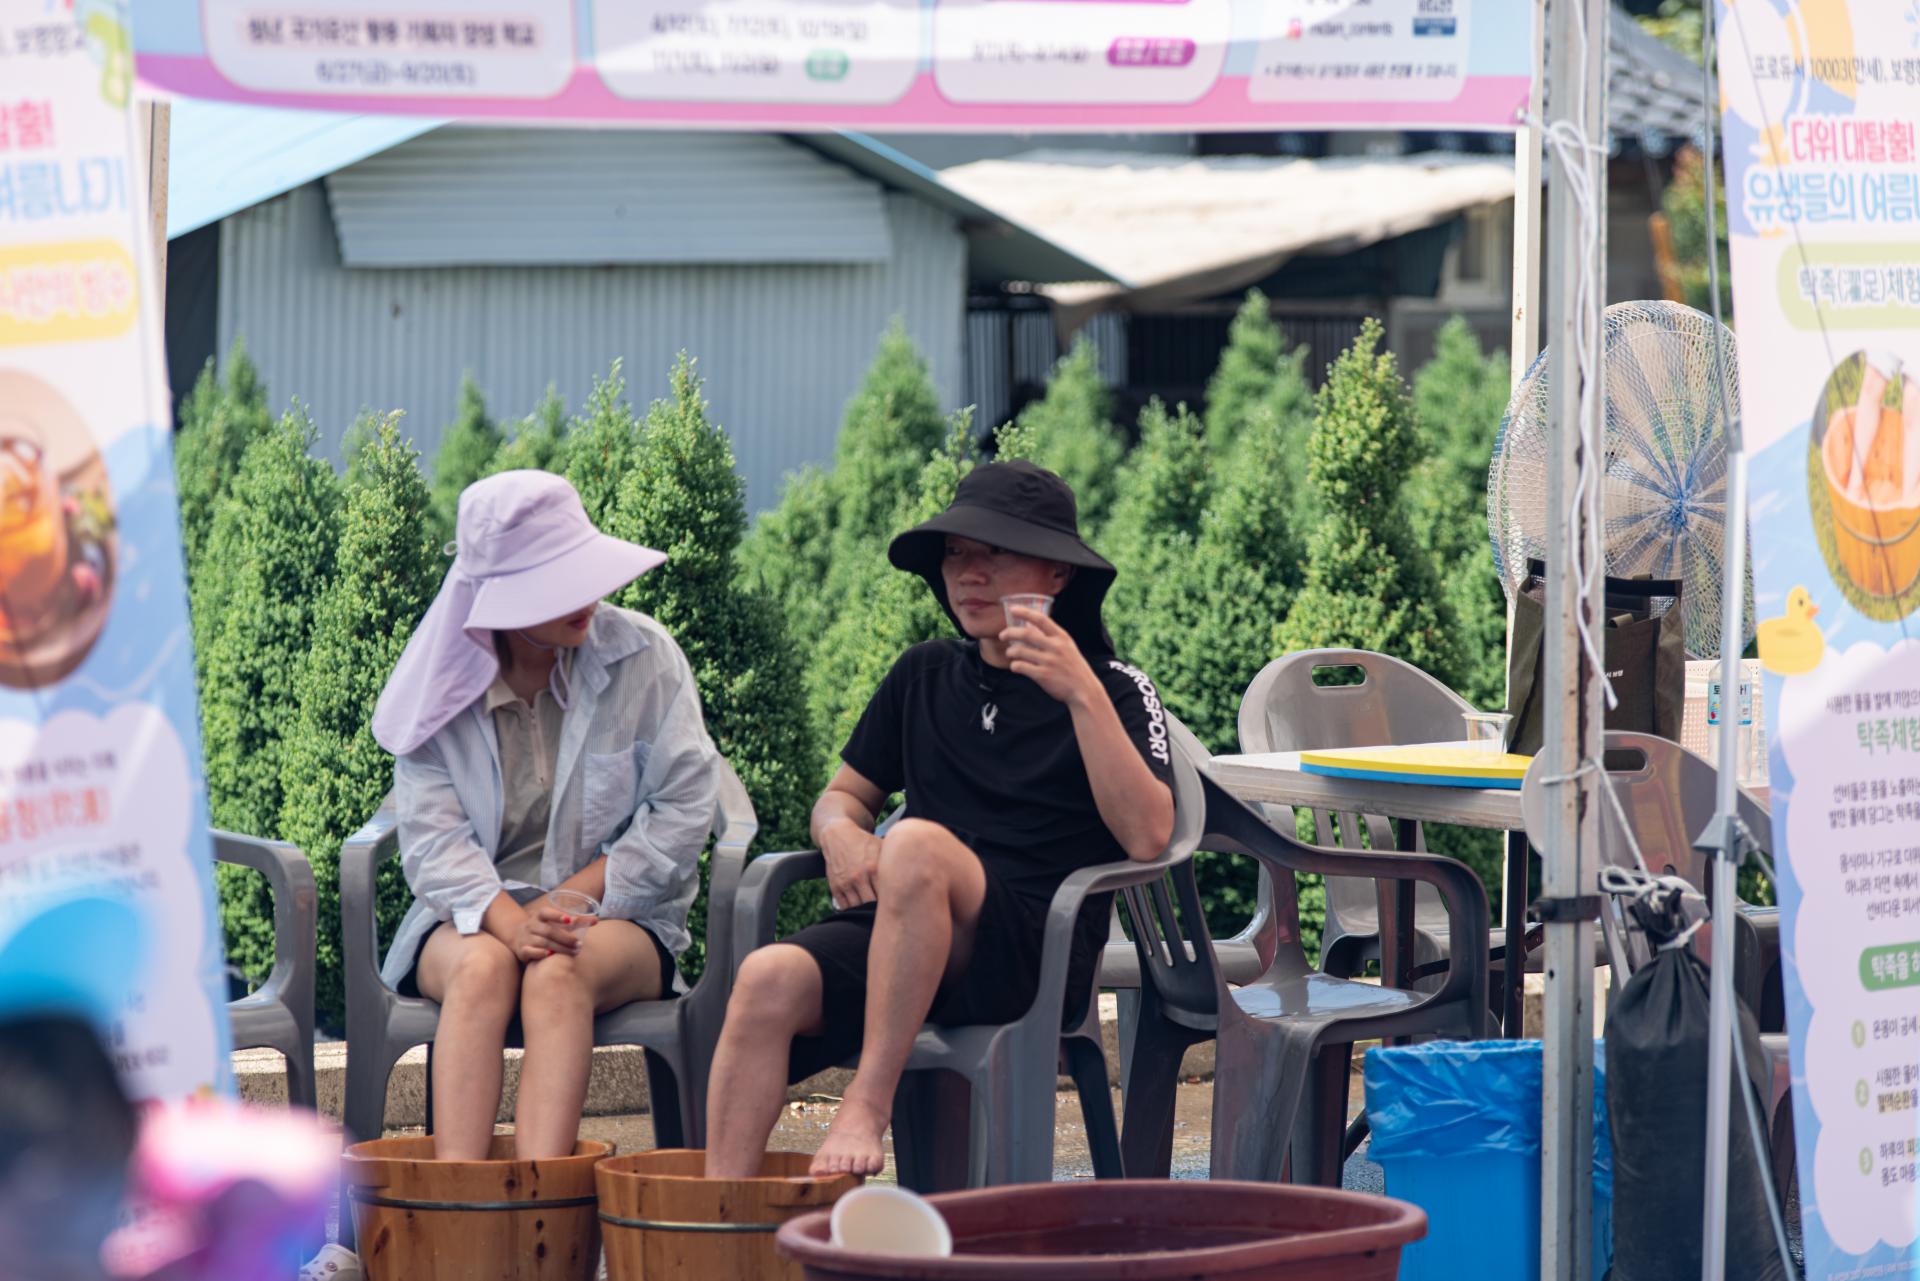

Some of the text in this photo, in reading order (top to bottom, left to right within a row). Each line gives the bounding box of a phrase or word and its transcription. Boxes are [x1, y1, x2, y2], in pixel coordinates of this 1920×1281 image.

[1791, 120, 1915, 164] 더위 대탈출!
[1749, 172, 1855, 224] 유생들의
